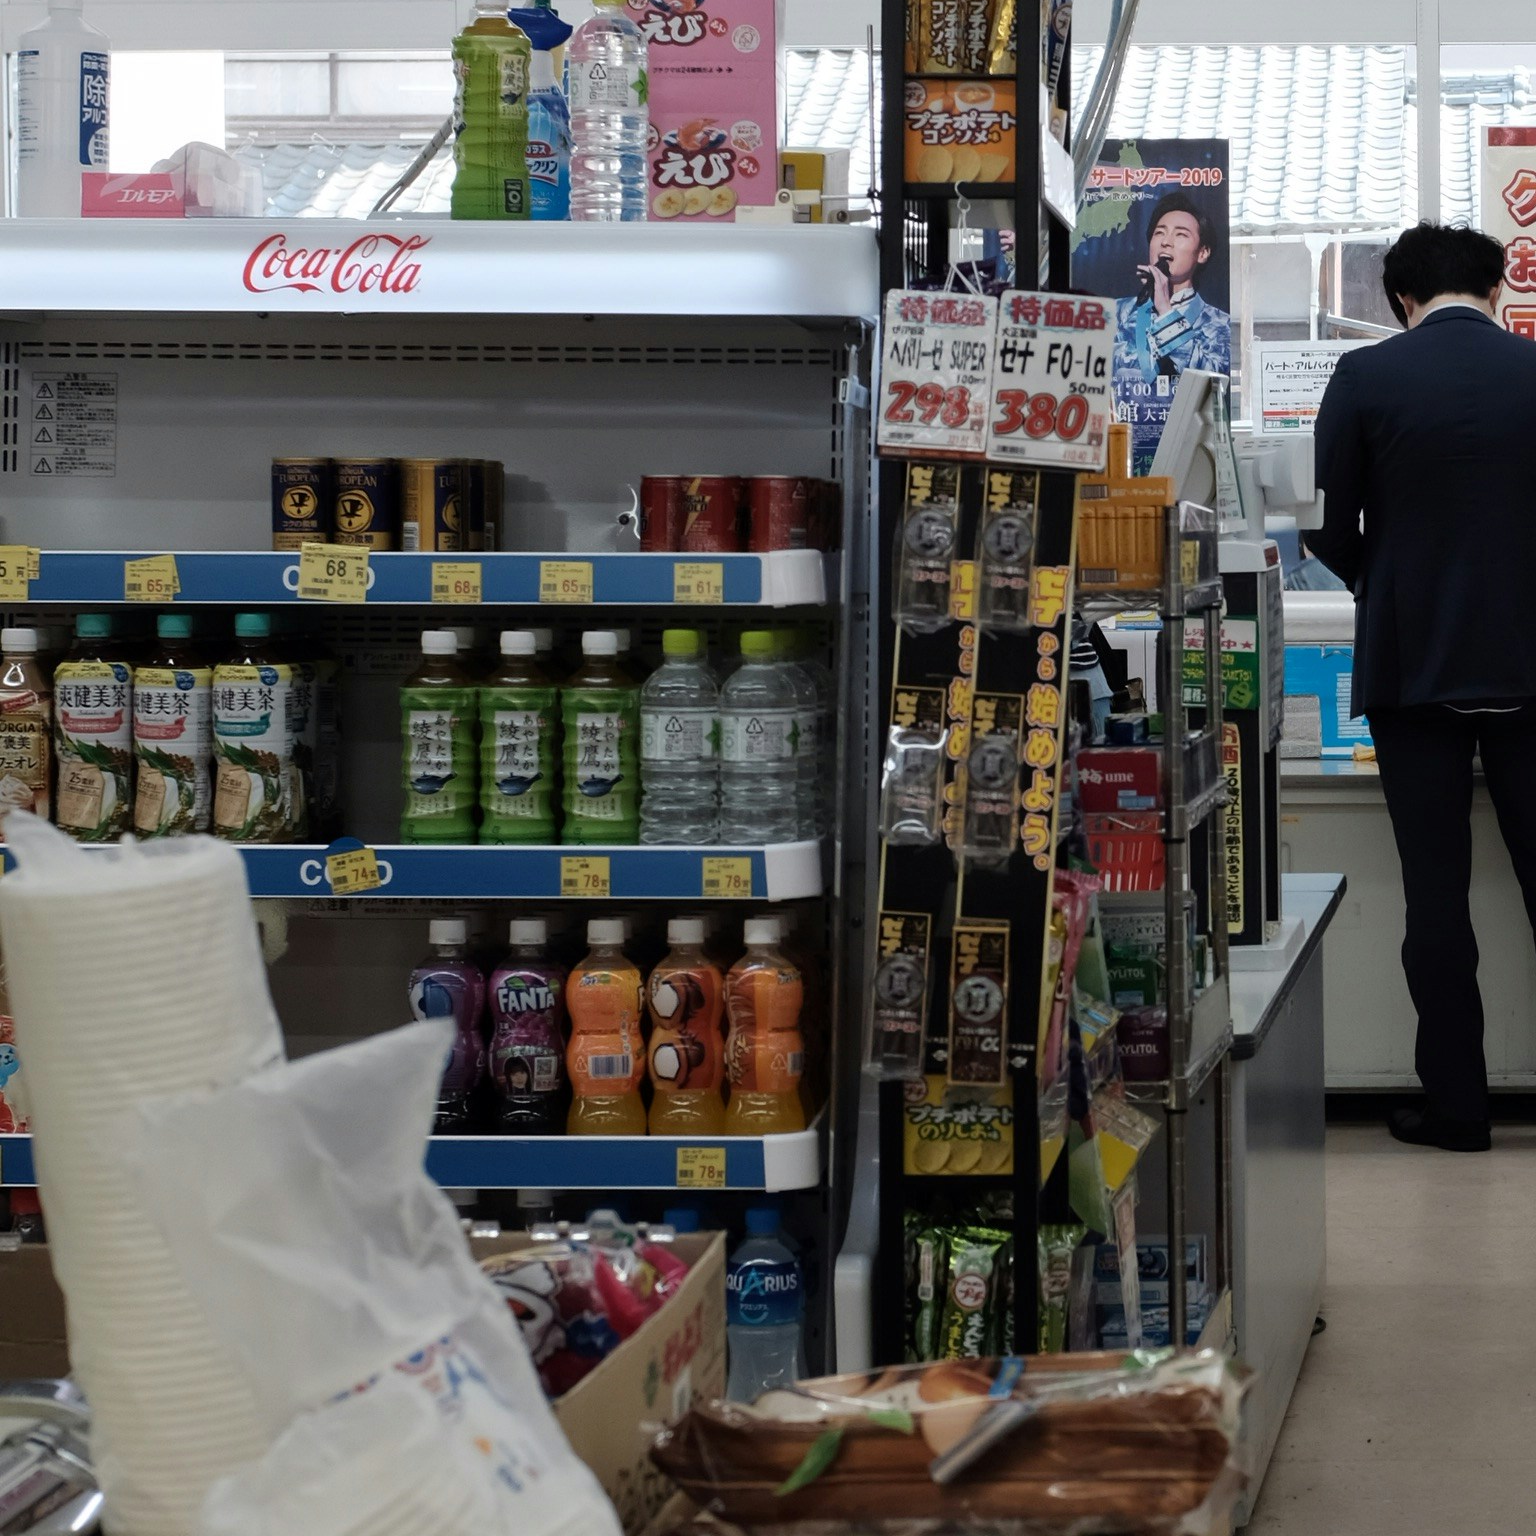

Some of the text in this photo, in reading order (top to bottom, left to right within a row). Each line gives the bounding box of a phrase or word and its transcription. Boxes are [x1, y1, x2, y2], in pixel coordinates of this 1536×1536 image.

[641, 12, 705, 44] えび
[968, 1, 988, 69] プチポテト
[84, 75, 110, 107] 除
[908, 112, 1017, 131] プチポテト
[658, 151, 732, 186] えび
[1090, 167, 1223, 187] サートツアー2019
[117, 189, 175, 203] エルモア
[1010, 296, 1107, 330] 特価品
[951, 342, 987, 371] SUPER
[1001, 339, 1035, 374] ゼナ
[1069, 382, 1105, 395] 50ml
[885, 381, 971, 427] 298
[993, 389, 1089, 440] 380
[279, 474, 320, 484] EUROPEAN
[326, 560, 347, 577] 68
[147, 580, 164, 593] 65
[454, 581, 471, 594] 68
[562, 580, 579, 594] 65
[697, 581, 711, 594] 61
[58, 684, 127, 708] 爽健美茶
[411, 720, 432, 767] 綾鷹
[434, 713, 448, 771] あやたか
[498, 720, 520, 767] 綾鷹
[522, 713, 536, 772] あやたか
[580, 722, 601, 768] 綾鷹
[603, 716, 615, 773] あやたか
[1105, 770, 1134, 783] ume
[300, 859, 393, 886] CD
[352, 868, 369, 883] 74
[584, 874, 600, 888] 78
[725, 874, 741, 888] 78
[499, 985, 556, 1013] FANTA
[700, 1165, 716, 1179] 78
